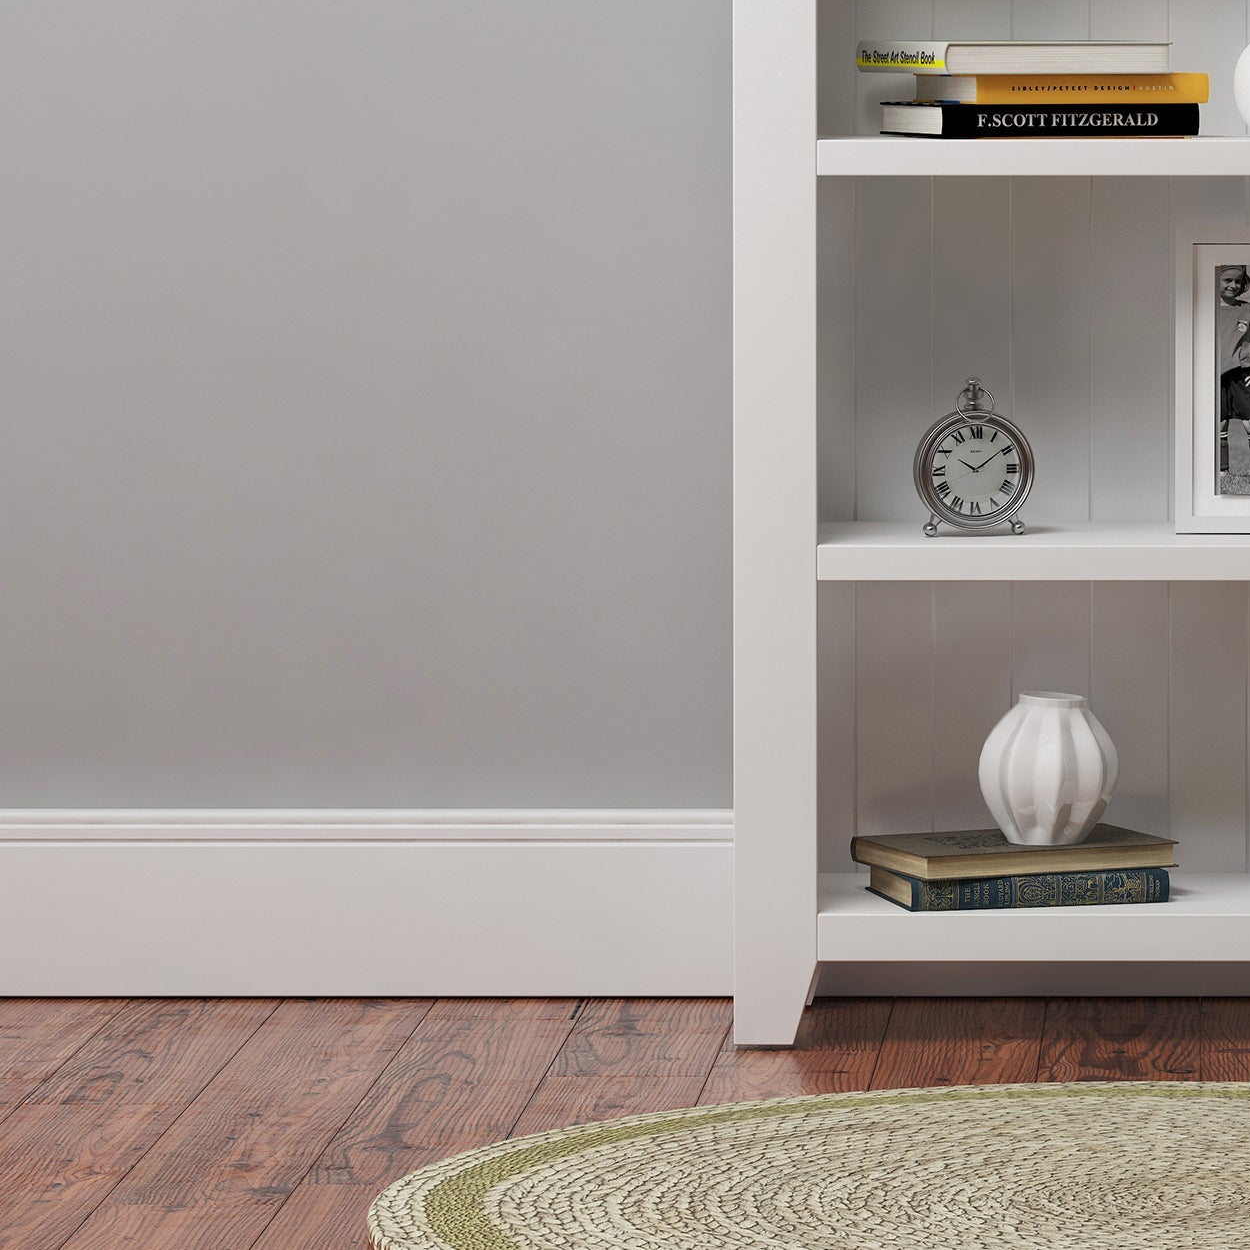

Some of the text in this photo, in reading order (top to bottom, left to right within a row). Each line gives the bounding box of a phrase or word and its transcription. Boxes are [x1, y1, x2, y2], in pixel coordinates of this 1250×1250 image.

[862, 50, 936, 65] The Street Art Stencil Book
[977, 113, 1159, 128] F.SCOTT FITZGERALD
[969, 426, 983, 440] XII
[1006, 463, 1019, 474] III
